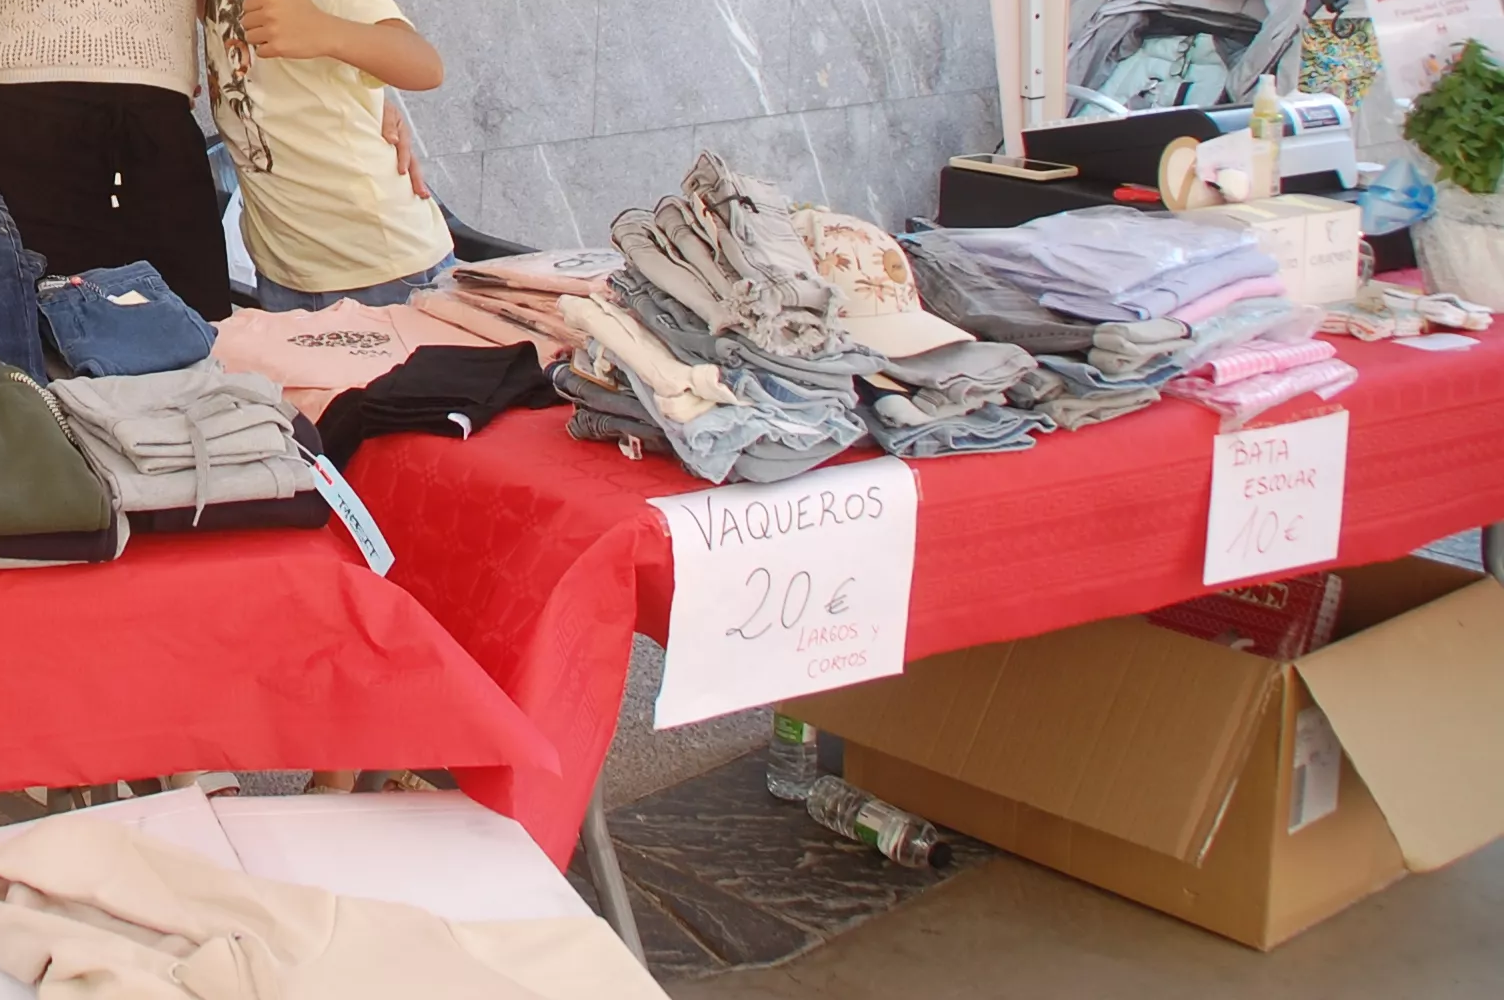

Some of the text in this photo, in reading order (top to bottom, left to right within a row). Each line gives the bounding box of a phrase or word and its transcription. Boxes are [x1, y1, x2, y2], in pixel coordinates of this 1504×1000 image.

[1228, 438, 1290, 467] BATA
[1243, 468, 1318, 500] ESCOLAR
[680, 485, 884, 551] VAQUEROS
[796, 622, 860, 652] LARGOS
[806, 650, 868, 679] CORTOS
